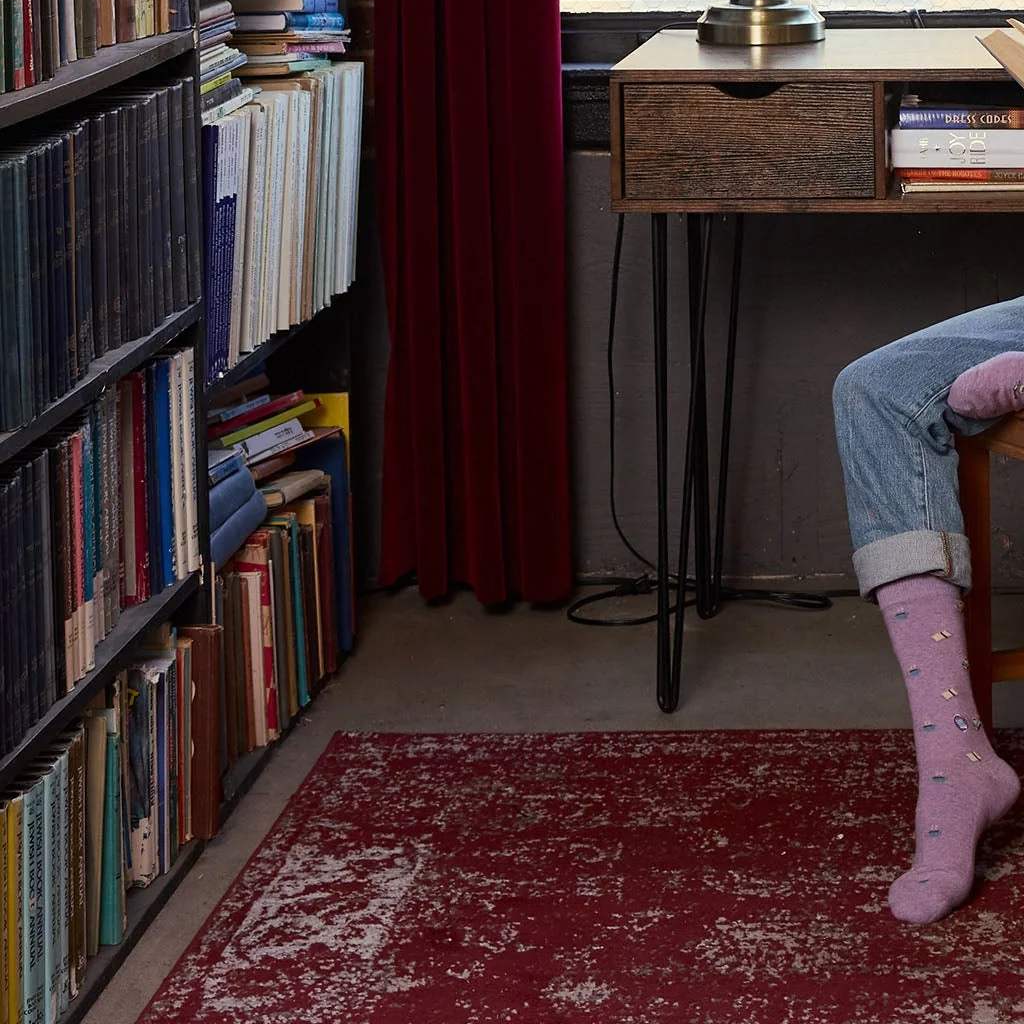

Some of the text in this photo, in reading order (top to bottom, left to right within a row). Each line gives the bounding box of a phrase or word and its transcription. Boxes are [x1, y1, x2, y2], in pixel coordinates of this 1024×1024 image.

[945, 114, 976, 124] DRESS
[979, 114, 1012, 124] CODES
[949, 131, 966, 164] JOY
[969, 131, 986, 165] RIDE
